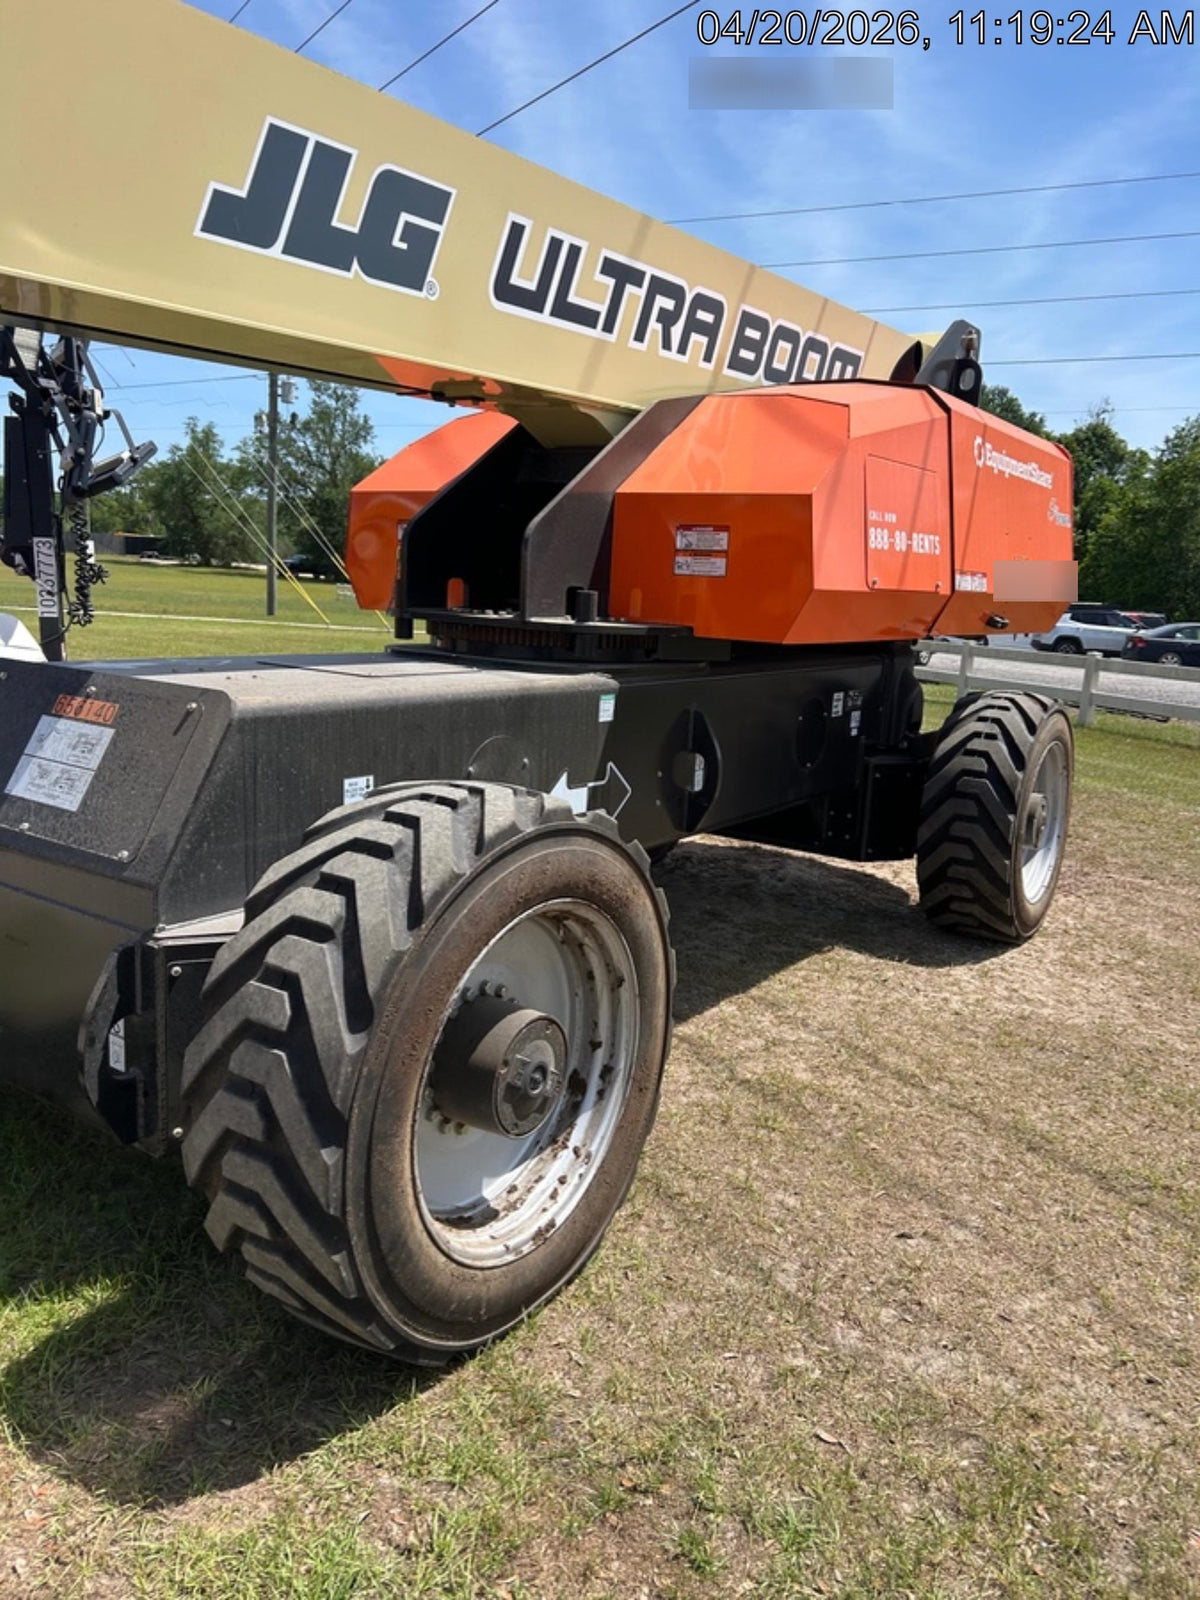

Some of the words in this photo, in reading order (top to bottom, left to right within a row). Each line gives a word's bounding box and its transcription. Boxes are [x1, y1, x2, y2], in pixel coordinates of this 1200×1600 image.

[193, 115, 457, 298] JLG
[489, 211, 727, 370] ULTRA
[723, 304, 865, 386] BOOM
